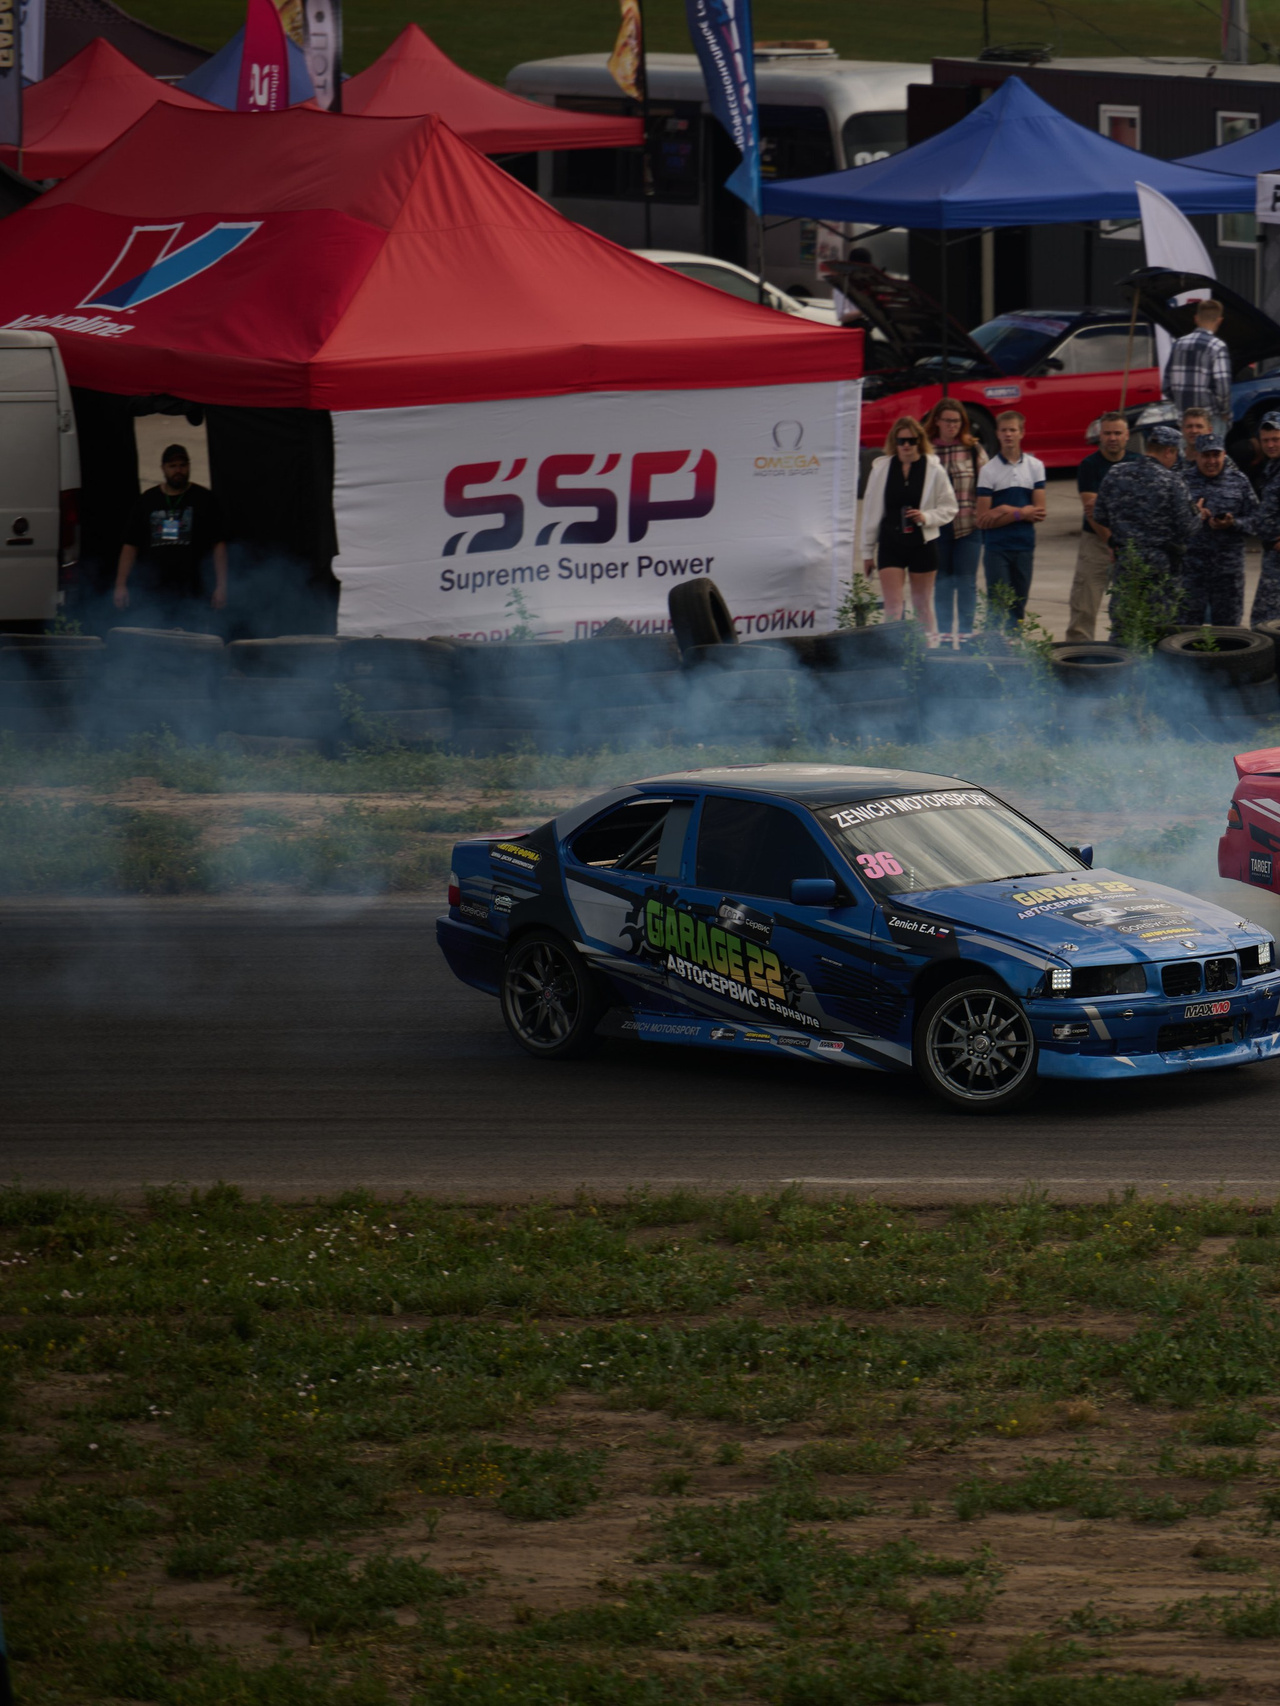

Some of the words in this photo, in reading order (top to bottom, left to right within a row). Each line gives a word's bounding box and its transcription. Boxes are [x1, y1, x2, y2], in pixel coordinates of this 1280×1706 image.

[1, 314, 136, 339] Valvoline
[754, 455, 820, 469] OMEGA
[442, 449, 717, 557] SSP
[440, 562, 550, 592] Supreme
[557, 557, 629, 582] Super
[636, 554, 714, 578] Power
[830, 801, 897, 828] ZENICH
[892, 793, 997, 811] MOTORSPORT
[856, 851, 903, 879] 36
[1251, 858, 1272, 873] TARGET
[1013, 884, 1100, 906] GARAGE
[1101, 881, 1136, 893] 22
[1017, 896, 1094, 920] АВТОСЕРВИС
[1124, 903, 1171, 912] сервис
[745, 918, 770, 933] сервис
[888, 916, 918, 931] Zenich
[919, 924, 936, 936] E.A.
[646, 899, 746, 983] GARAGE
[746, 942, 786, 1000] 22
[667, 953, 759, 1008] АВТОСЕРВИС
[760, 996, 766, 1006] в
[768, 998, 820, 1028] Барнауле
[1184, 1000, 1230, 1018] MAXMO
[621, 1020, 650, 1031] ZENICH
[649, 1022, 702, 1036] MOTORSPORT
